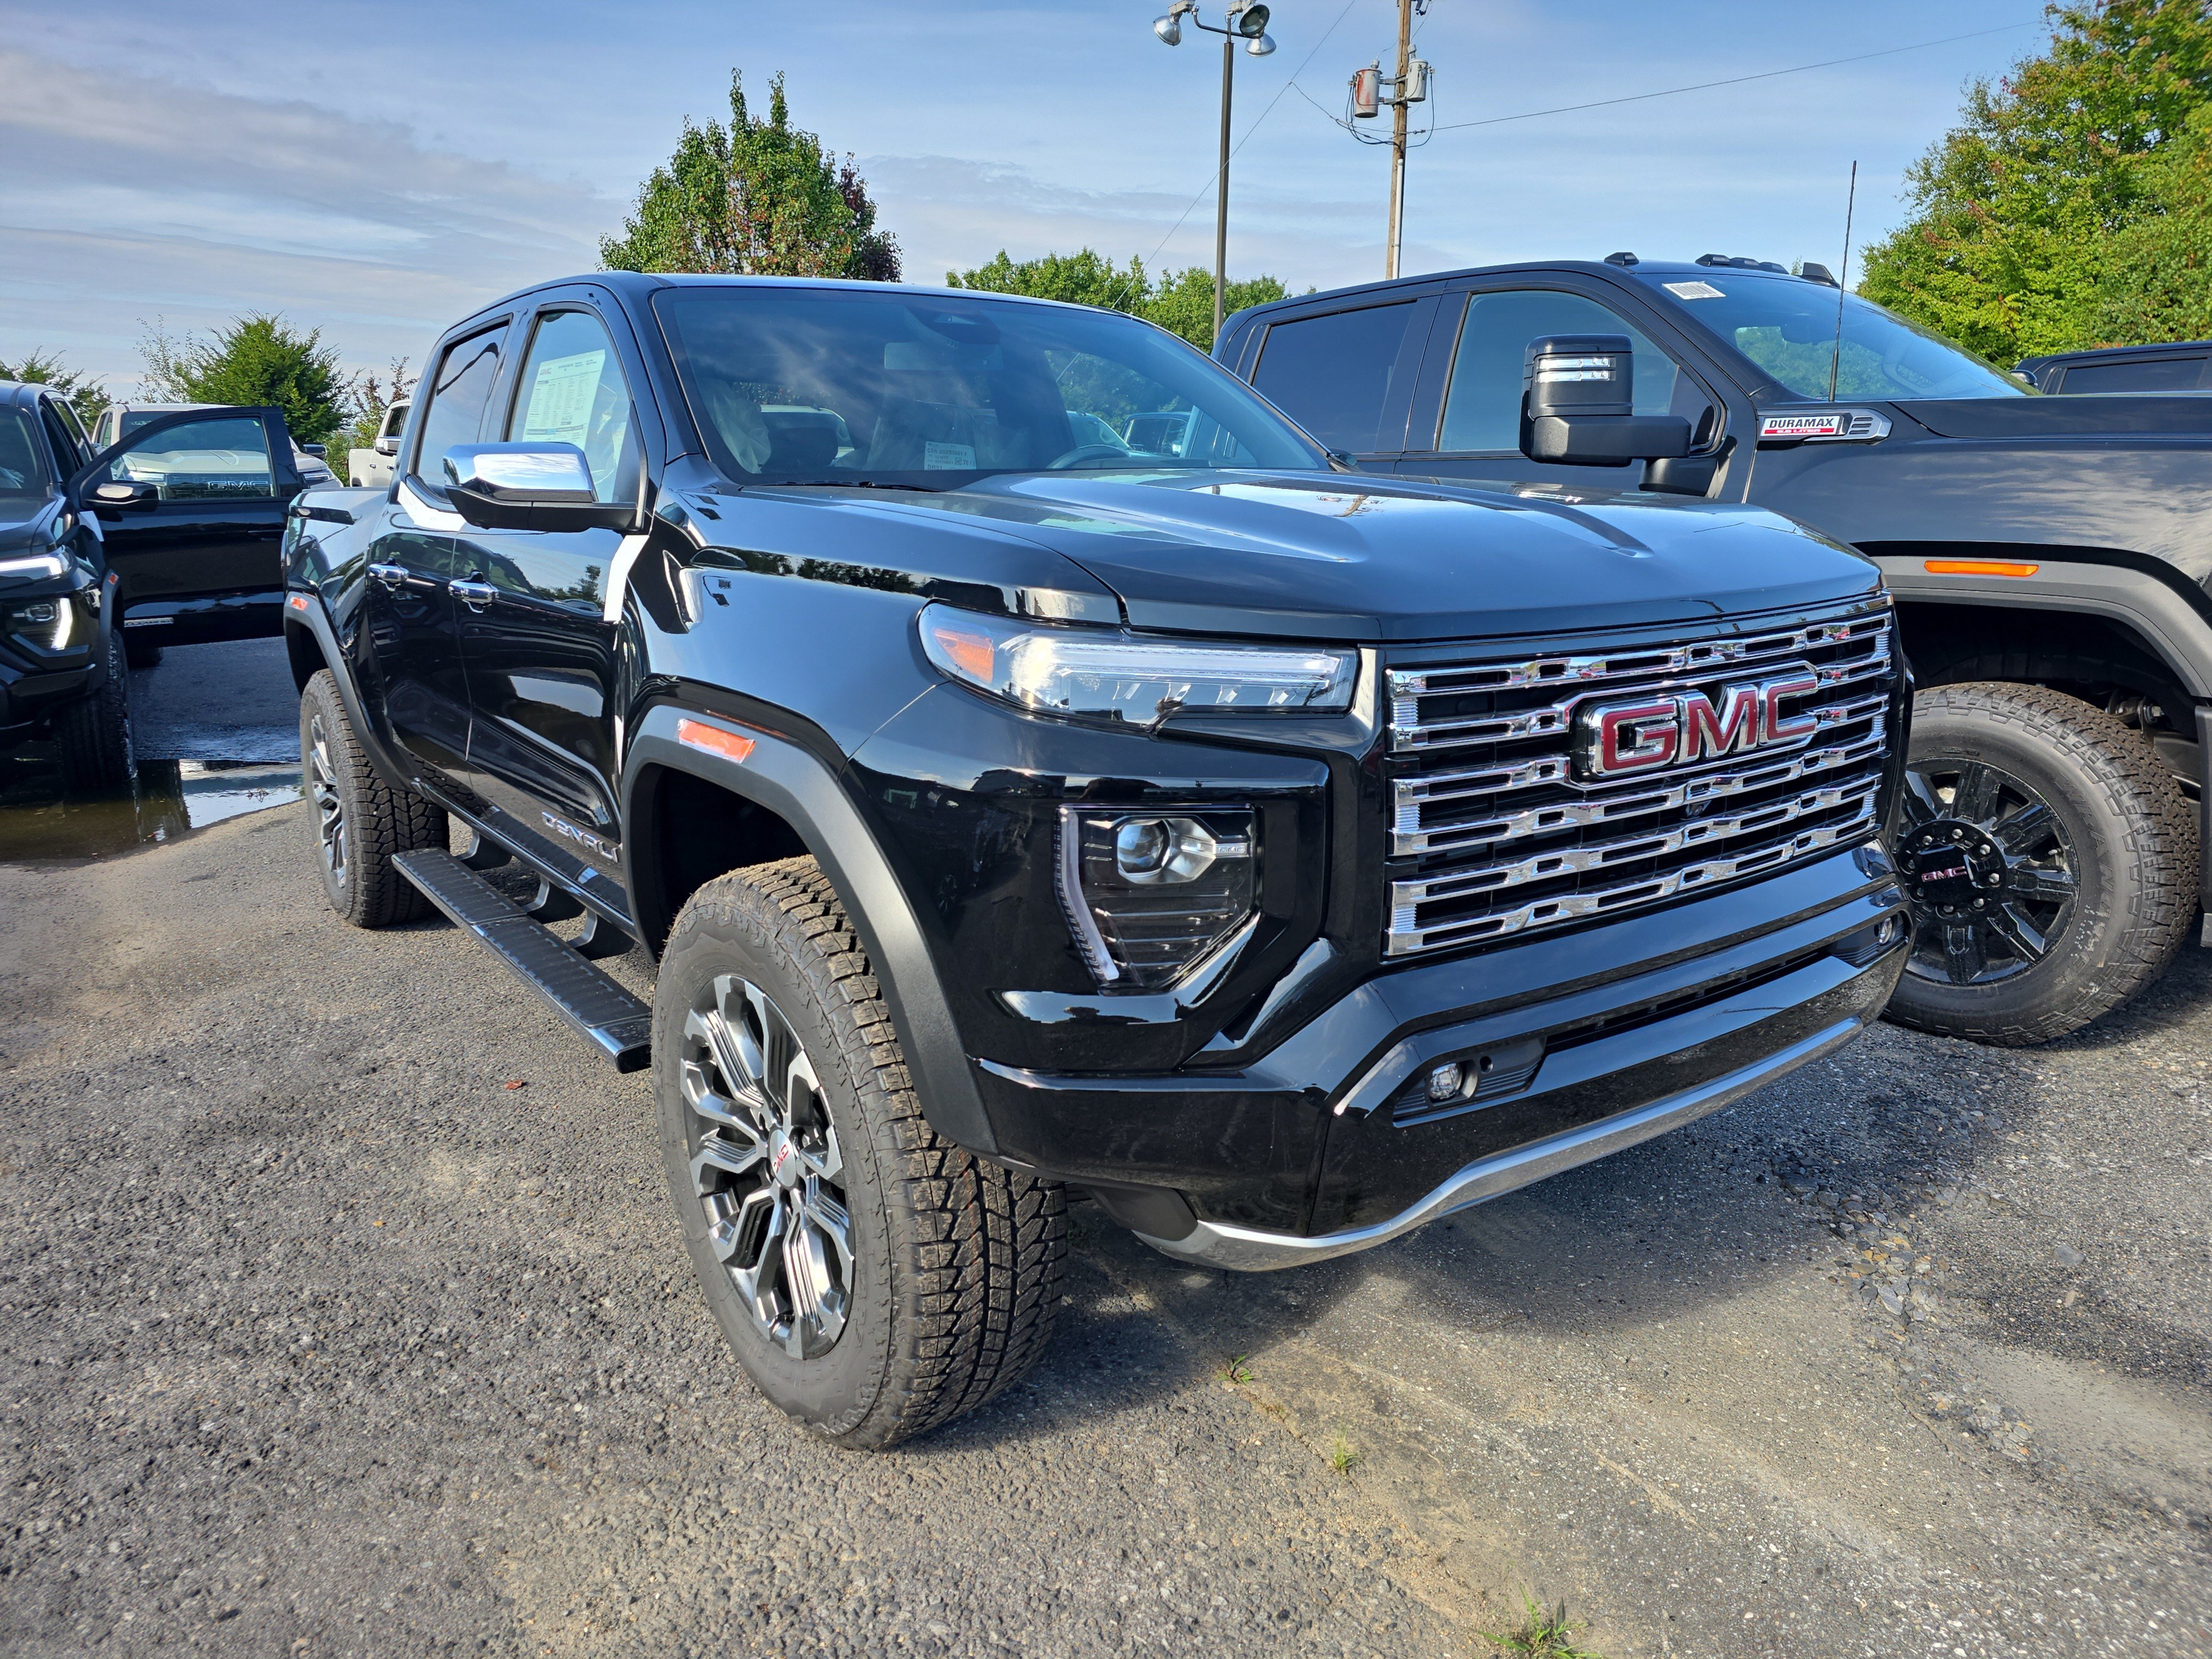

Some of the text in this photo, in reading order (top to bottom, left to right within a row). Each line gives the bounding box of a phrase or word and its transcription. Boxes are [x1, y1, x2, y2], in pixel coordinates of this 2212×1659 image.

[1769, 418, 1835, 428] DURAMAX
[208, 480, 269, 491] GMC
[1588, 674, 1818, 777] GMC
[542, 811, 623, 863] DENALI
[1921, 866, 1967, 882] GMC
[774, 1144, 789, 1174] GMC
